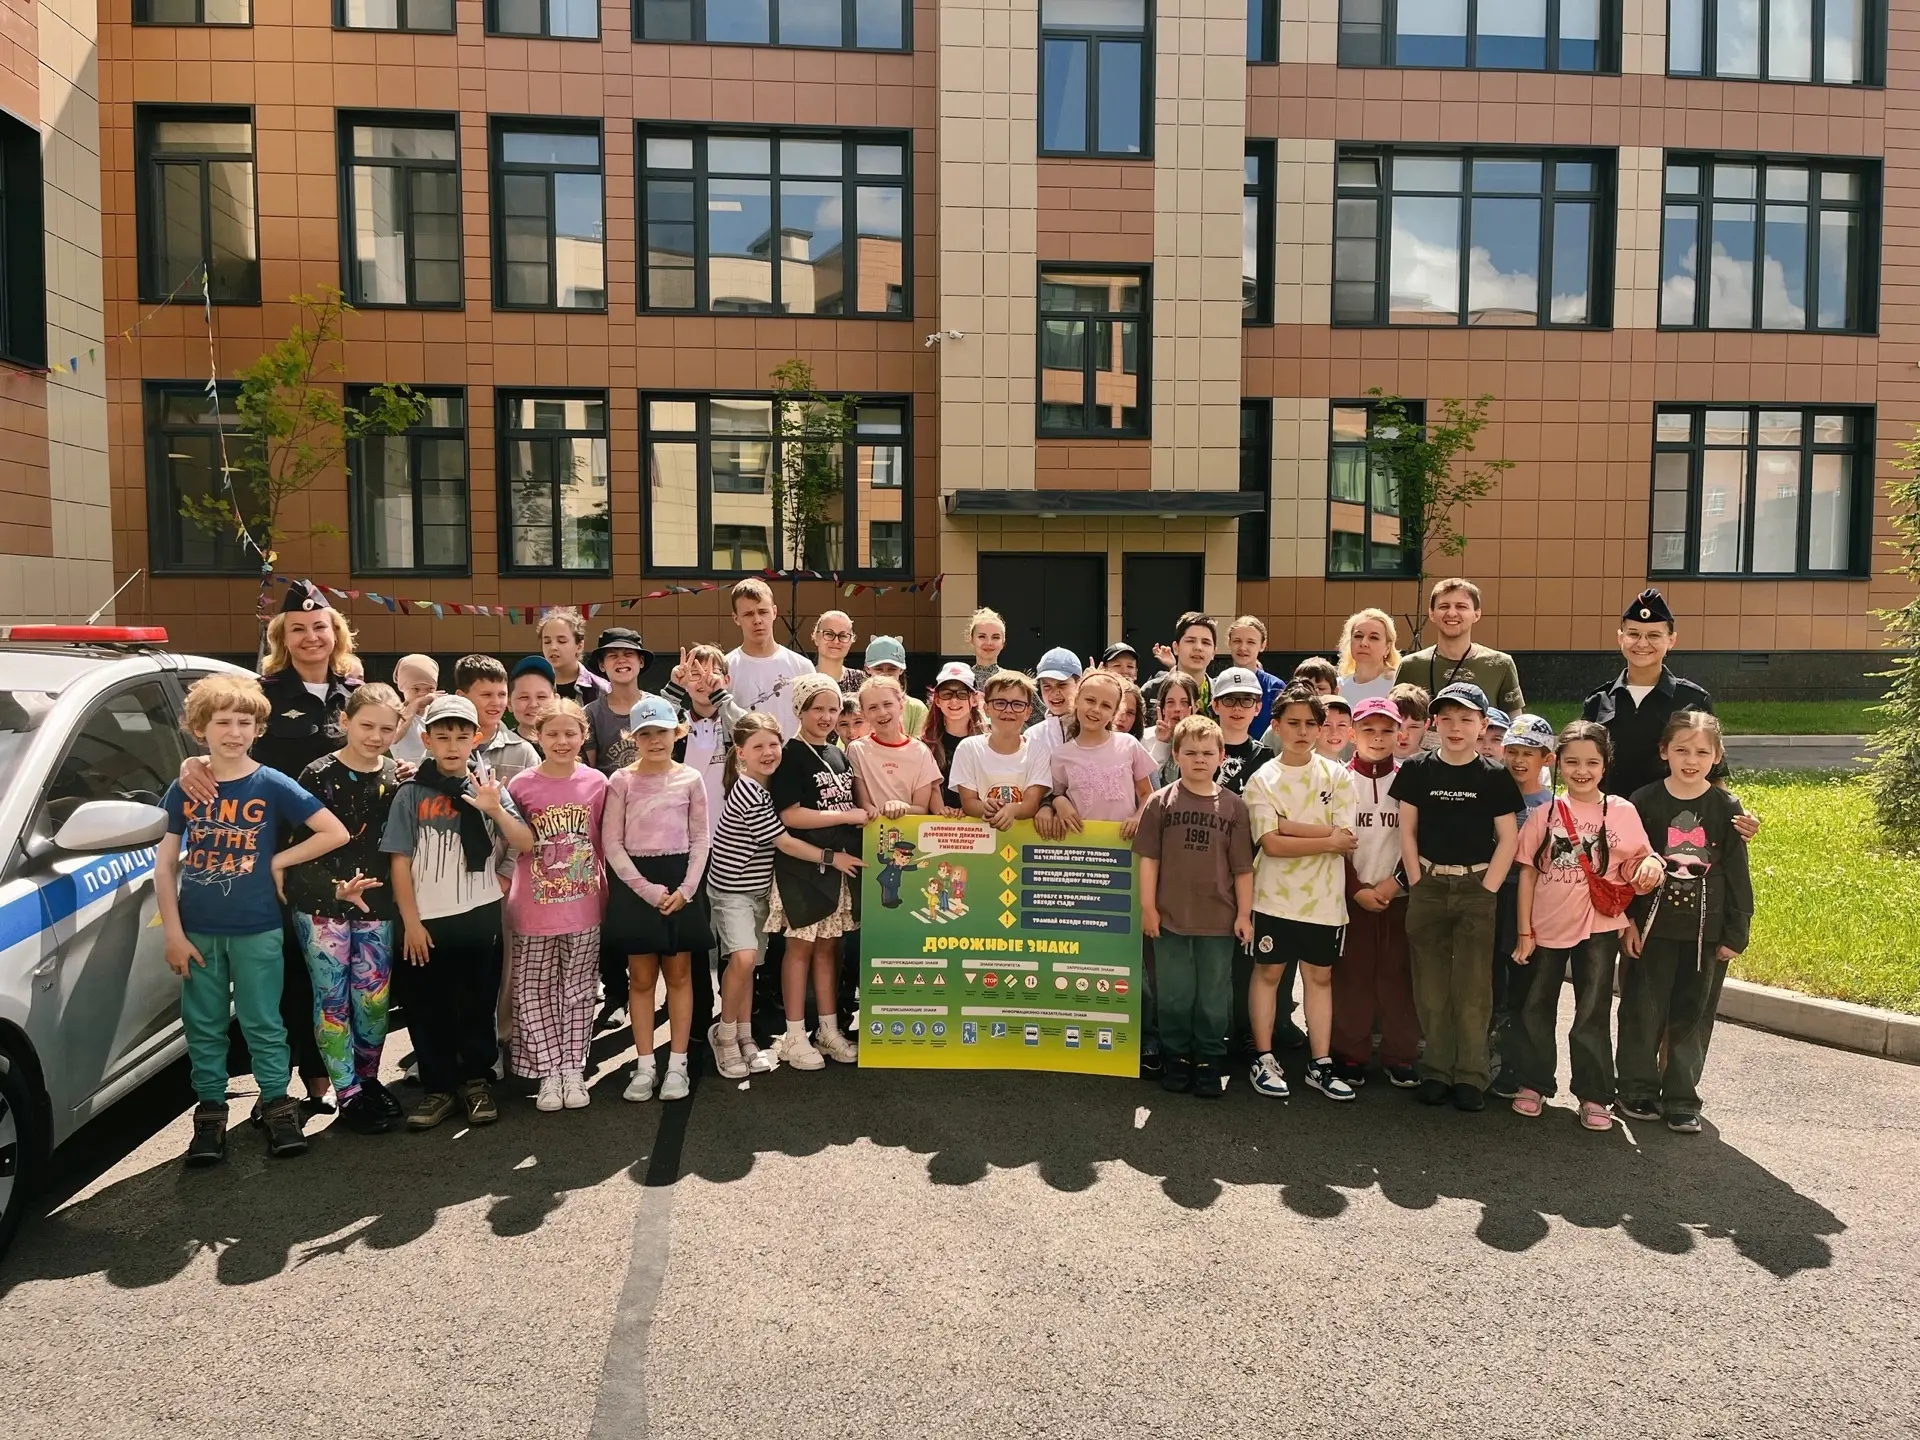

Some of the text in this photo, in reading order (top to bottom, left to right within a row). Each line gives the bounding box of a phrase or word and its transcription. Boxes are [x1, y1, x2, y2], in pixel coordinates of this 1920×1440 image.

[1429, 790, 1477, 799] #КРАСАВЧИК
[183, 798, 267, 824] KING
[1356, 812, 1373, 827] KE
[1164, 811, 1232, 835] BROOKLYN
[212, 827, 258, 850] THE
[1033, 848, 1063, 856] ПЕРЕХОДИ
[1064, 849, 1086, 857] ДОРОГУ
[83, 848, 157, 893] ПОЛИЦИ
[1063, 894, 1101, 902] ТРОЛЛЕЙБУС
[923, 936, 1080, 955] ДОРОЖНЫЕ ЗНАКИ
[933, 1025, 944, 1033] 50
